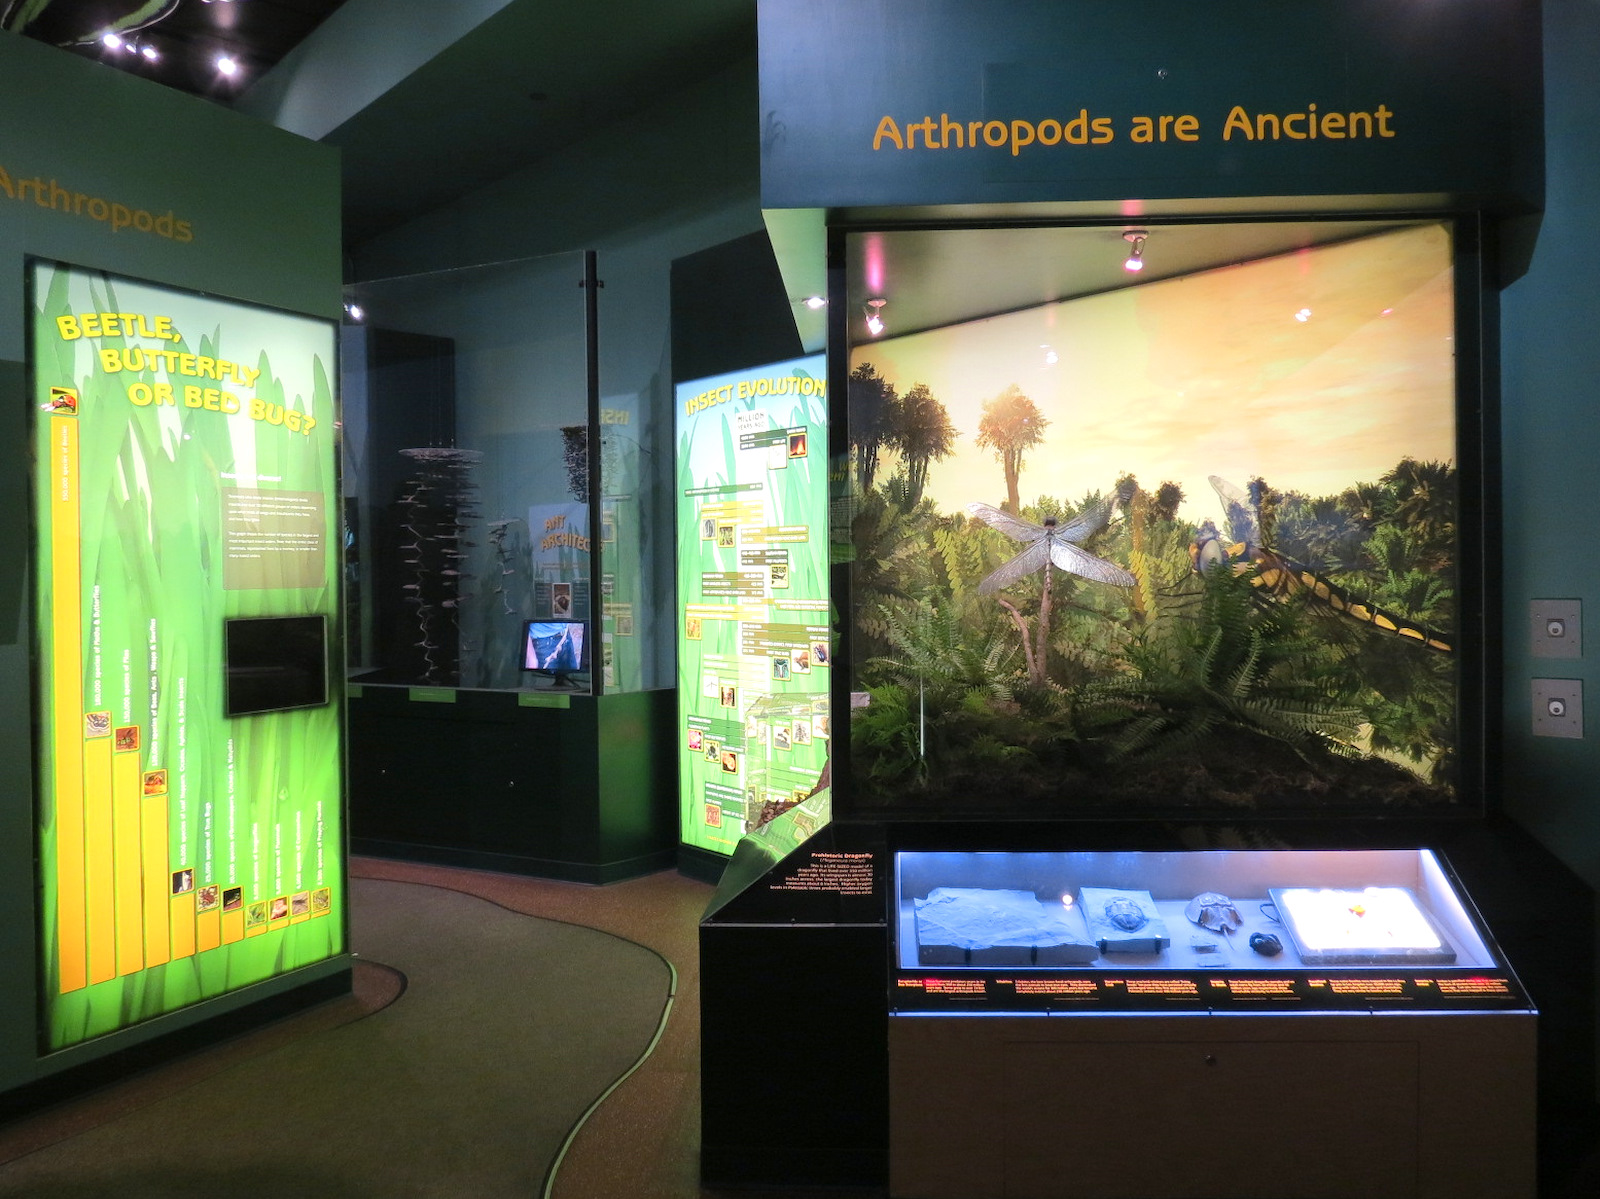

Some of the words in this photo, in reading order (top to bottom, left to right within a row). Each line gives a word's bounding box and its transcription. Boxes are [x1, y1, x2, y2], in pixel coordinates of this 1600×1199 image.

[872, 108, 1114, 157] Arthropods
[1130, 114, 1200, 144] are
[1222, 103, 1396, 141] Ancient
[56, 312, 182, 344] BEETLE,
[100, 348, 260, 388] BUTTERFLY
[128, 382, 175, 407] OR
[184, 385, 240, 414] BED
[250, 398, 316, 436] BUG?
[684, 384, 734, 416] INSECT
[737, 376, 826, 399] EVOLUTION
[738, 412, 765, 422] MILLION
[545, 515, 566, 531] ANT
[541, 532, 605, 552] ARCHITEC
